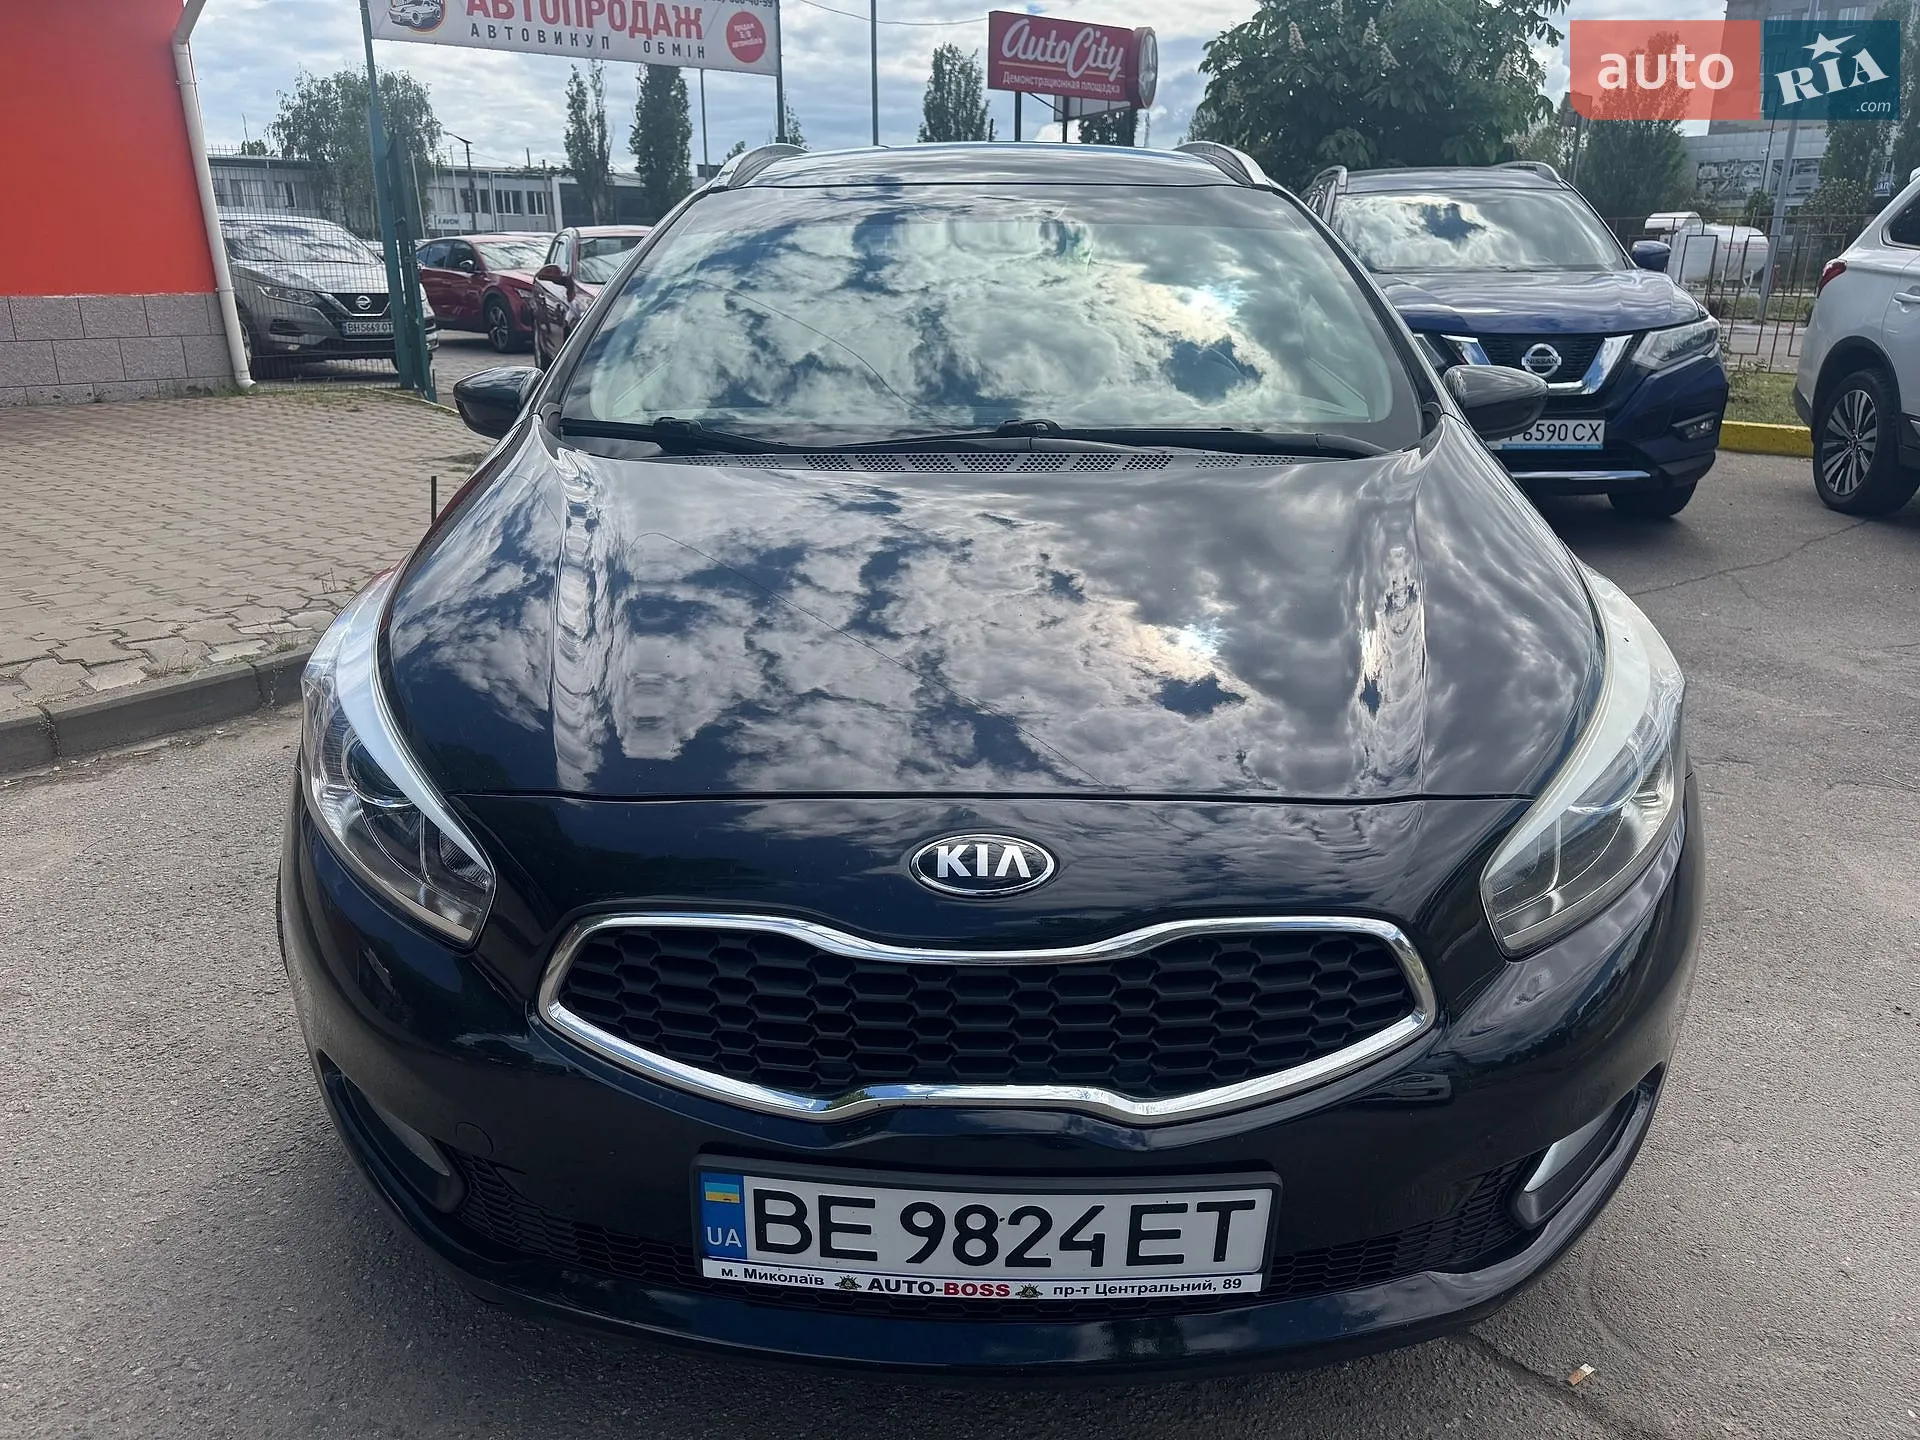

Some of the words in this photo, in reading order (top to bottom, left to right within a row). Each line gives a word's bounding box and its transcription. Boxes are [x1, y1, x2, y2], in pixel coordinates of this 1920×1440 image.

[471, 22, 610, 50] АВТОВИКУП
[643, 40, 705, 59] ОБМІН
[1002, 18, 1124, 82] AutoCity
[1002, 71, 1080, 91] Демонстрационная
[1081, 80, 1121, 95] площадка
[1573, 423, 1602, 441] CX
[936, 844, 1032, 878] KIA
[706, 1226, 743, 1249] UA
[752, 1187, 879, 1262] BE
[899, 1202, 1106, 1268] 9824
[1125, 1199, 1257, 1267] ET
[721, 1267, 738, 1278] м.
[743, 1267, 825, 1286] Миколаїв
[867, 1277, 1011, 1297] AUTO-BOSS
[1053, 1284, 1090, 1297] пр-т
[1095, 1278, 1218, 1296] Центральний,
[1222, 1278, 1243, 1290] 89
